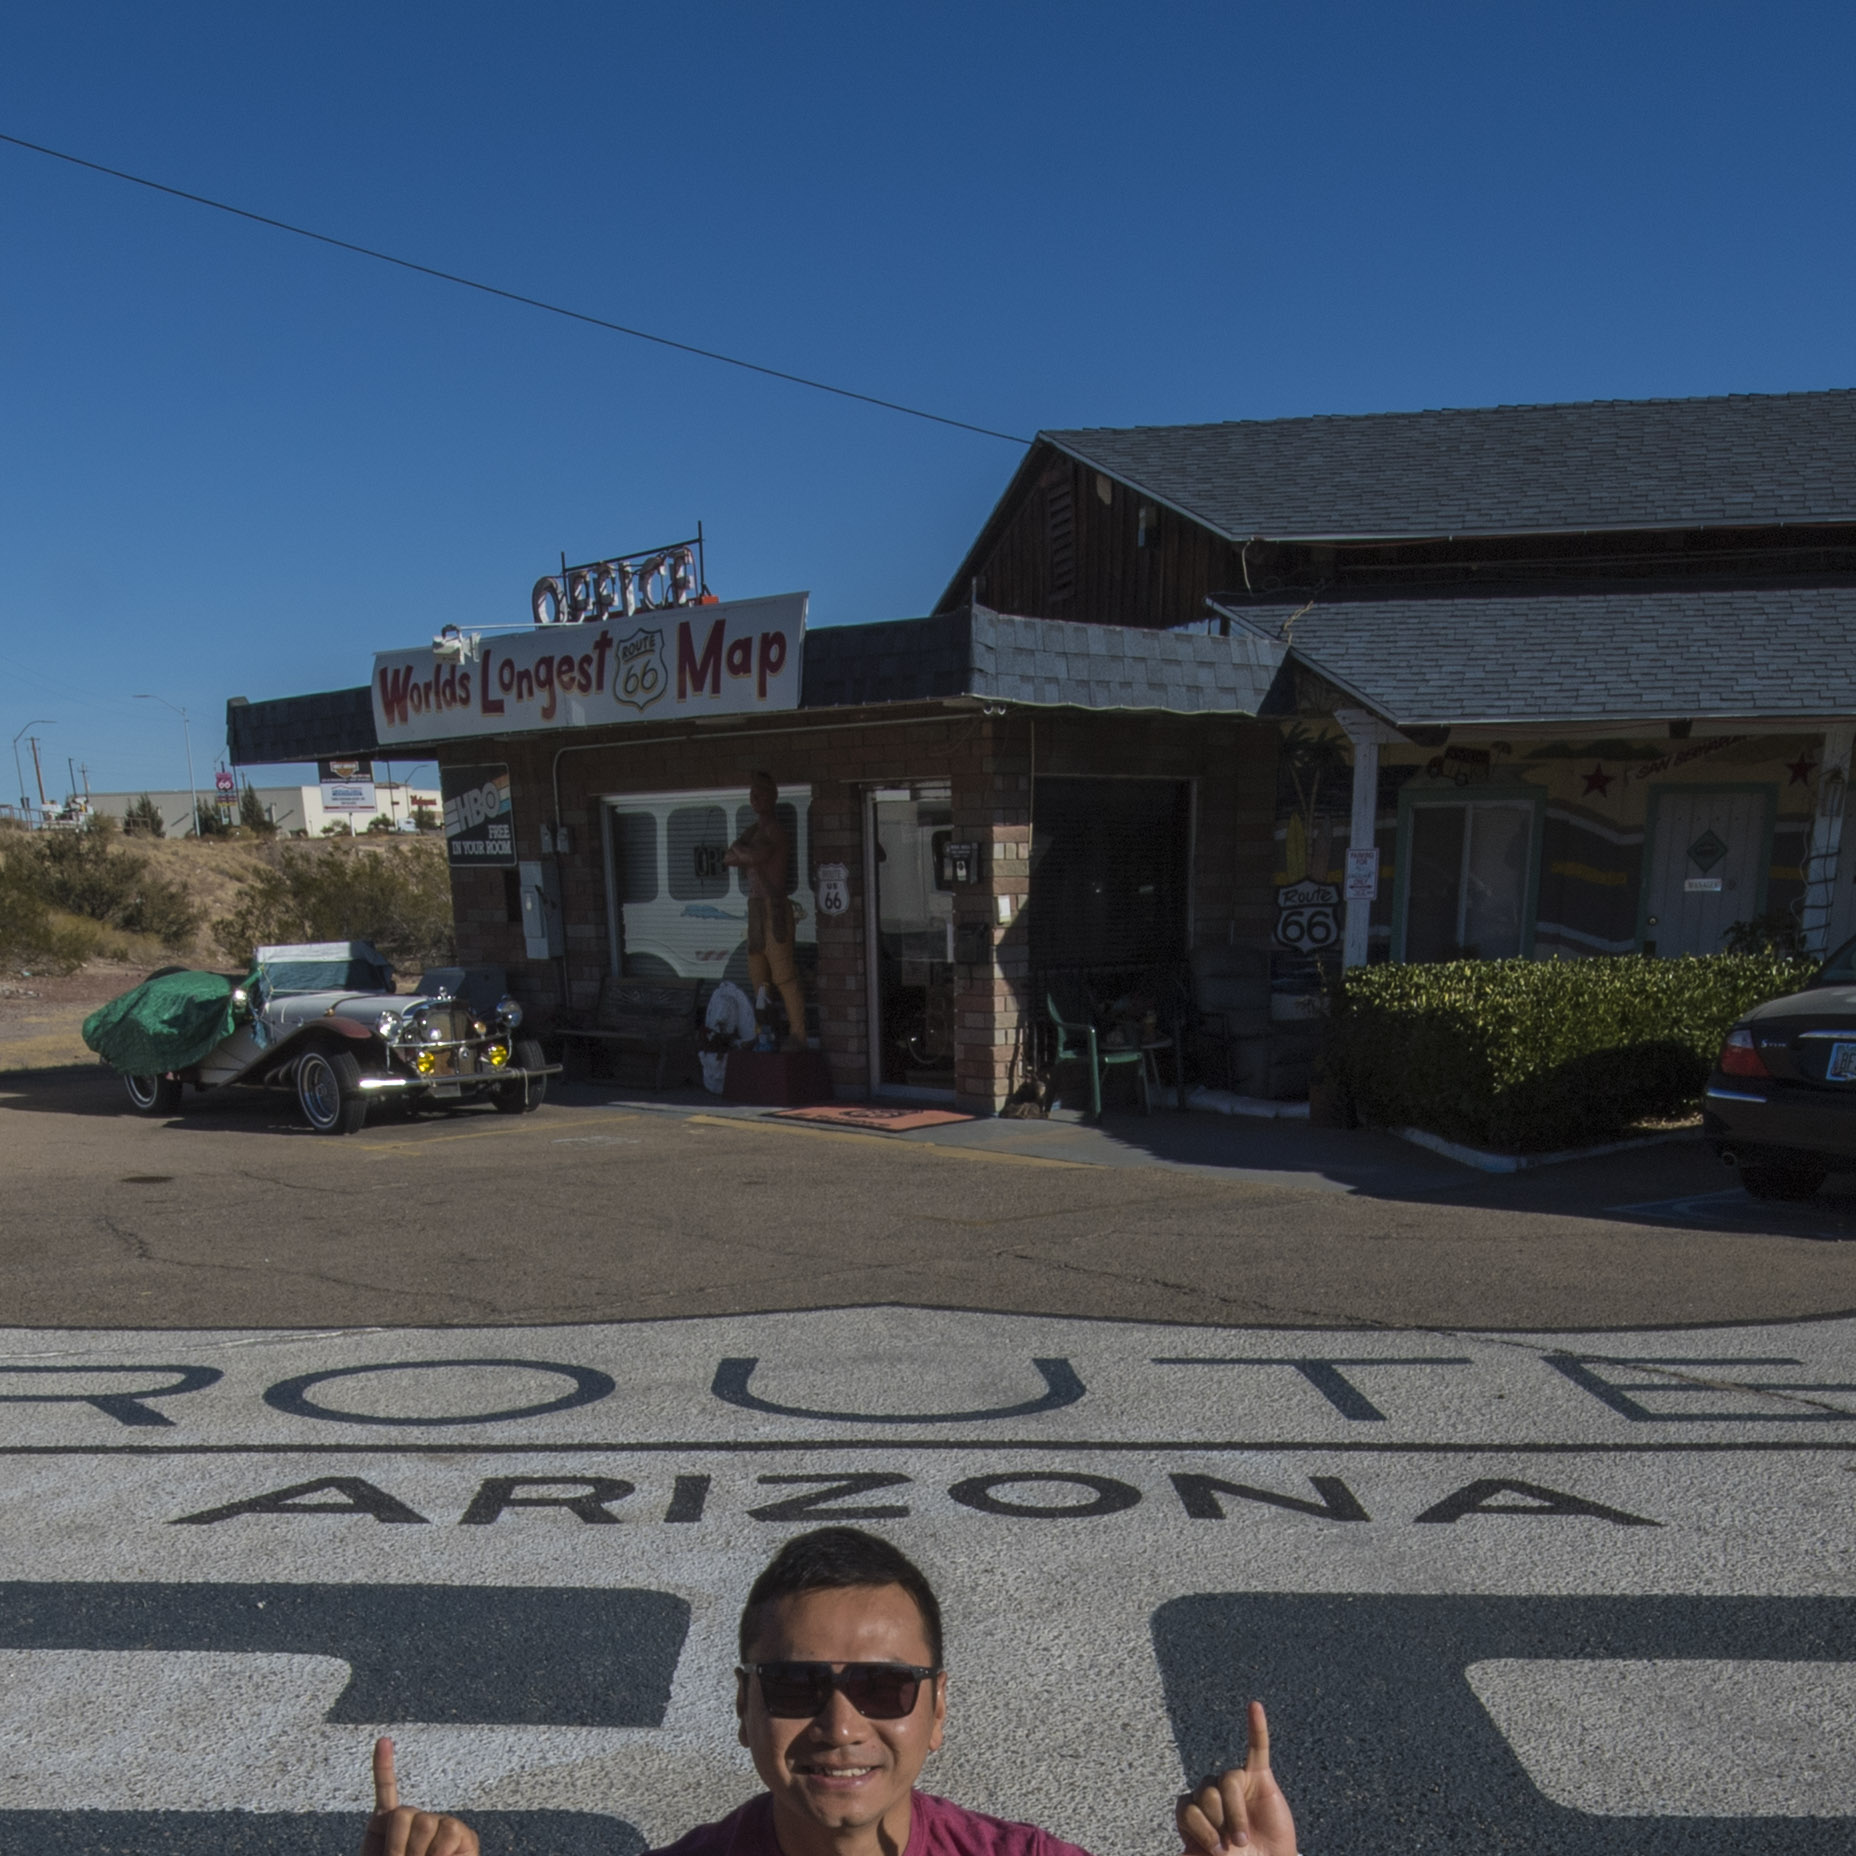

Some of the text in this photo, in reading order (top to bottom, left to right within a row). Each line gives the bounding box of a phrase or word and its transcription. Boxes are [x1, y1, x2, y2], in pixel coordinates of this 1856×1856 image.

[532, 546, 693, 624] OFFICE
[621, 636, 656, 660] ROUTE
[378, 619, 787, 726] Worlds Longest Map
[623, 664, 659, 694] 66
[218, 781, 231, 790] 66
[455, 782, 500, 831] HBO
[488, 824, 510, 839] FREE
[452, 841, 512, 855] IN YOUR ROOM
[825, 892, 841, 909] 66
[1282, 887, 1333, 904] Route
[1281, 909, 1332, 945] 66
[166, 1472, 1664, 1527] ARIZONA
